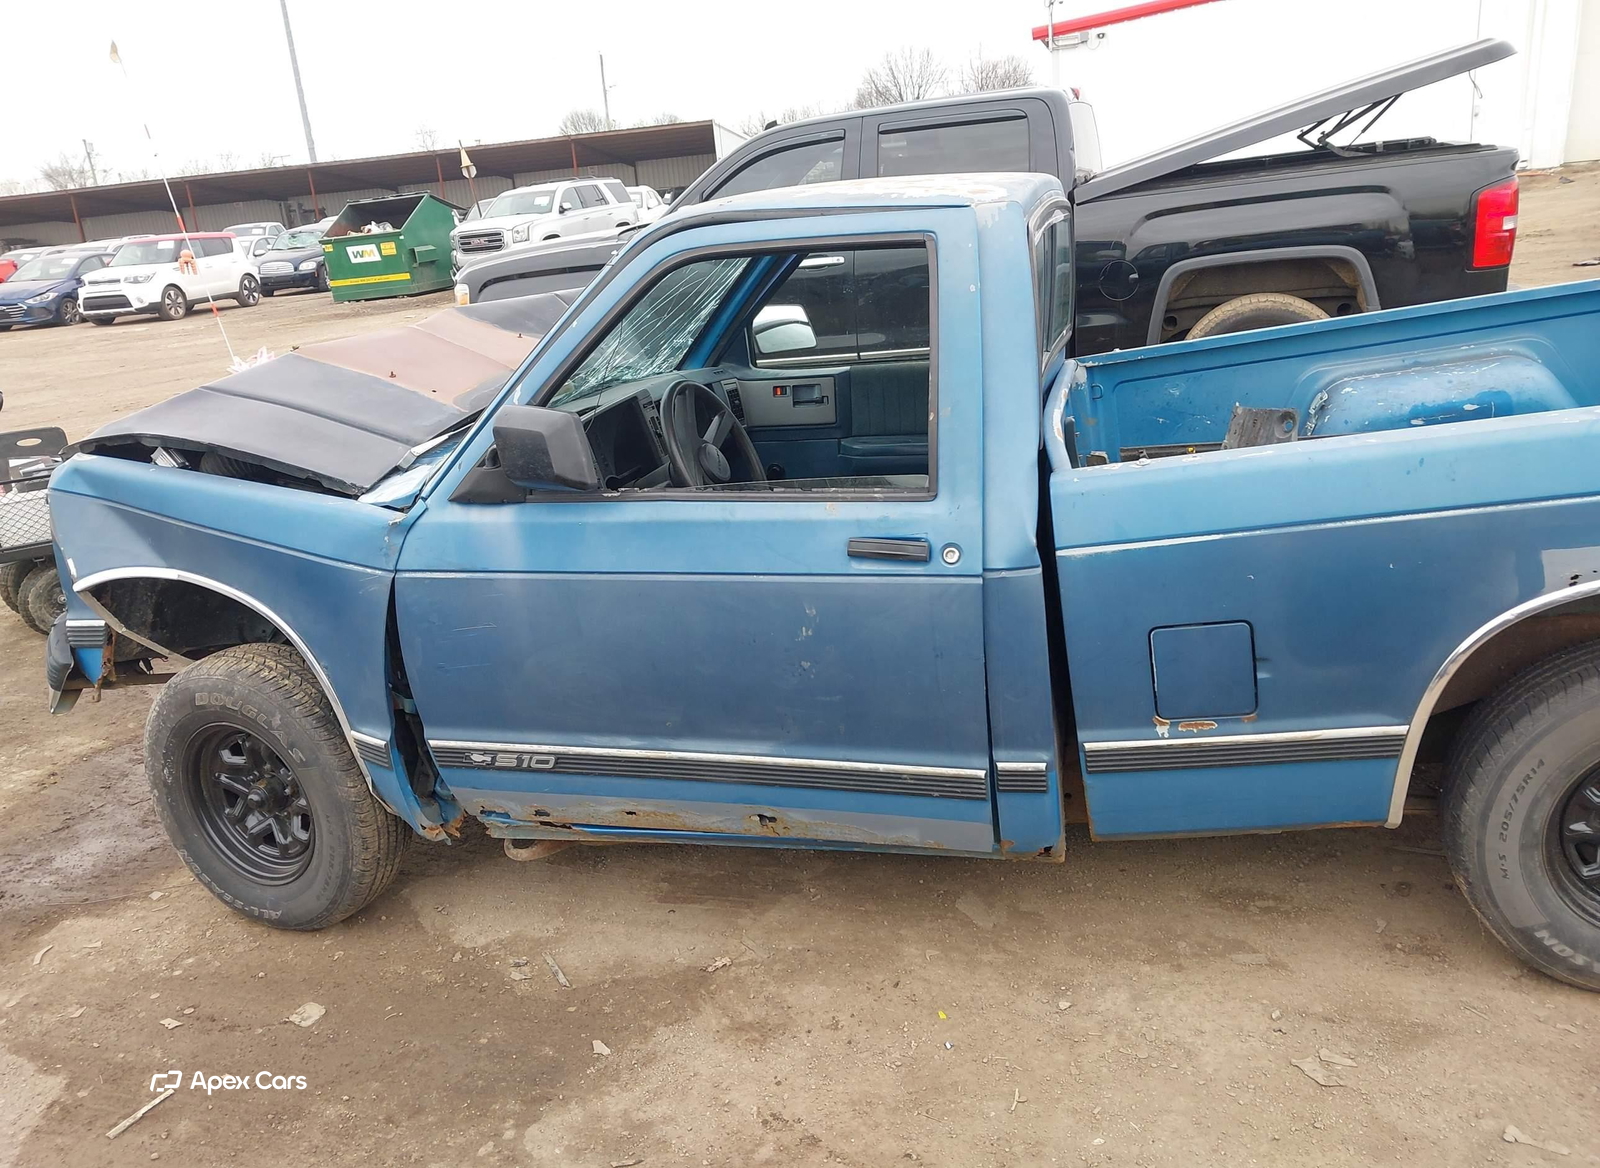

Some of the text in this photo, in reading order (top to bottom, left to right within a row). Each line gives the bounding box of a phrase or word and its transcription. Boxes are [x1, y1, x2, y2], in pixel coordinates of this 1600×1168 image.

[352, 250, 376, 259] WM
[195, 692, 306, 764] DOUGLAS
[496, 754, 555, 769] S10
[1499, 758, 1546, 844] 205/75R14
